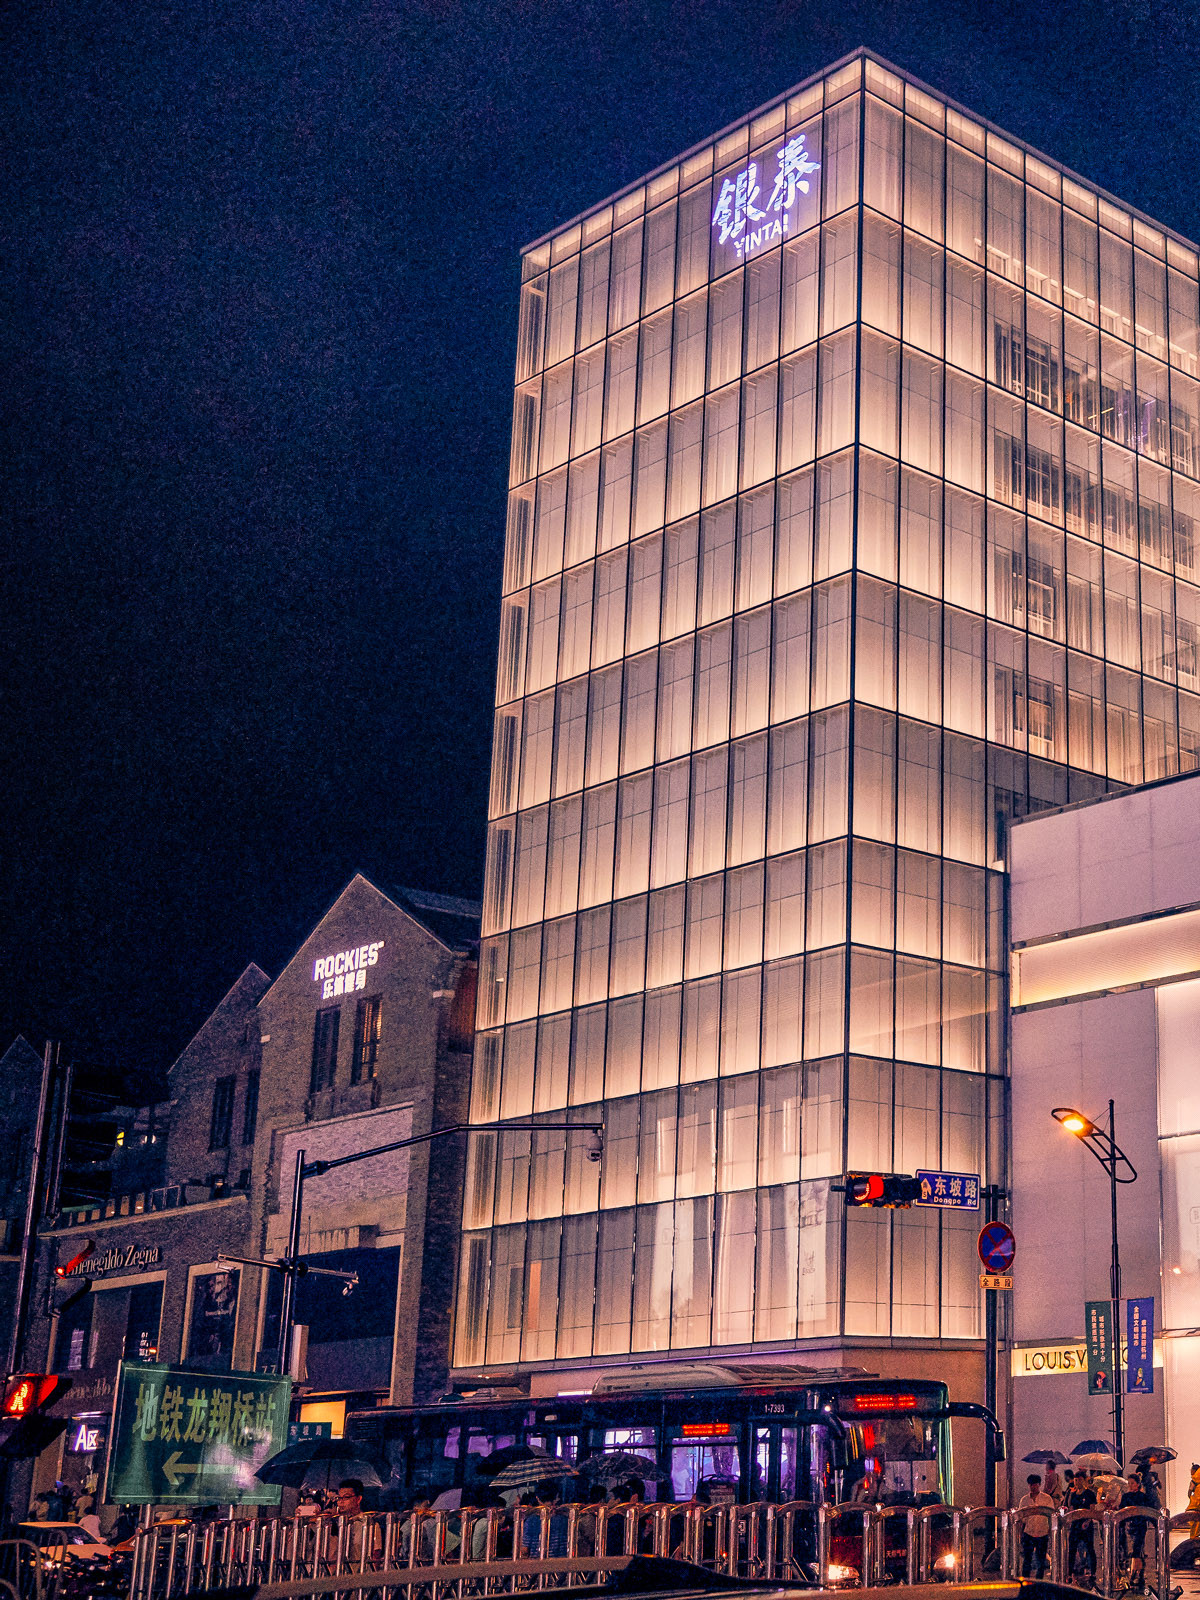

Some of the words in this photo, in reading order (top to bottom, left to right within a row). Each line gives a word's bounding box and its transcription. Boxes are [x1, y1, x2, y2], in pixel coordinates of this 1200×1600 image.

[733, 213, 789, 258] YINTAI
[312, 942, 379, 981] ROCKIES
[934, 1176, 977, 1199] 东坡路
[933, 1196, 962, 1206] Dongpo
[66, 1248, 123, 1277] menegildo
[124, 1244, 160, 1270] Zegna
[982, 1277, 1012, 1288] 全路段
[1025, 1350, 1075, 1371] LOUIS
[132, 1384, 276, 1446] 地铁龙翔桥站
[764, 1403, 785, 1414] 1-7393
[75, 1424, 99, 1452] A区
